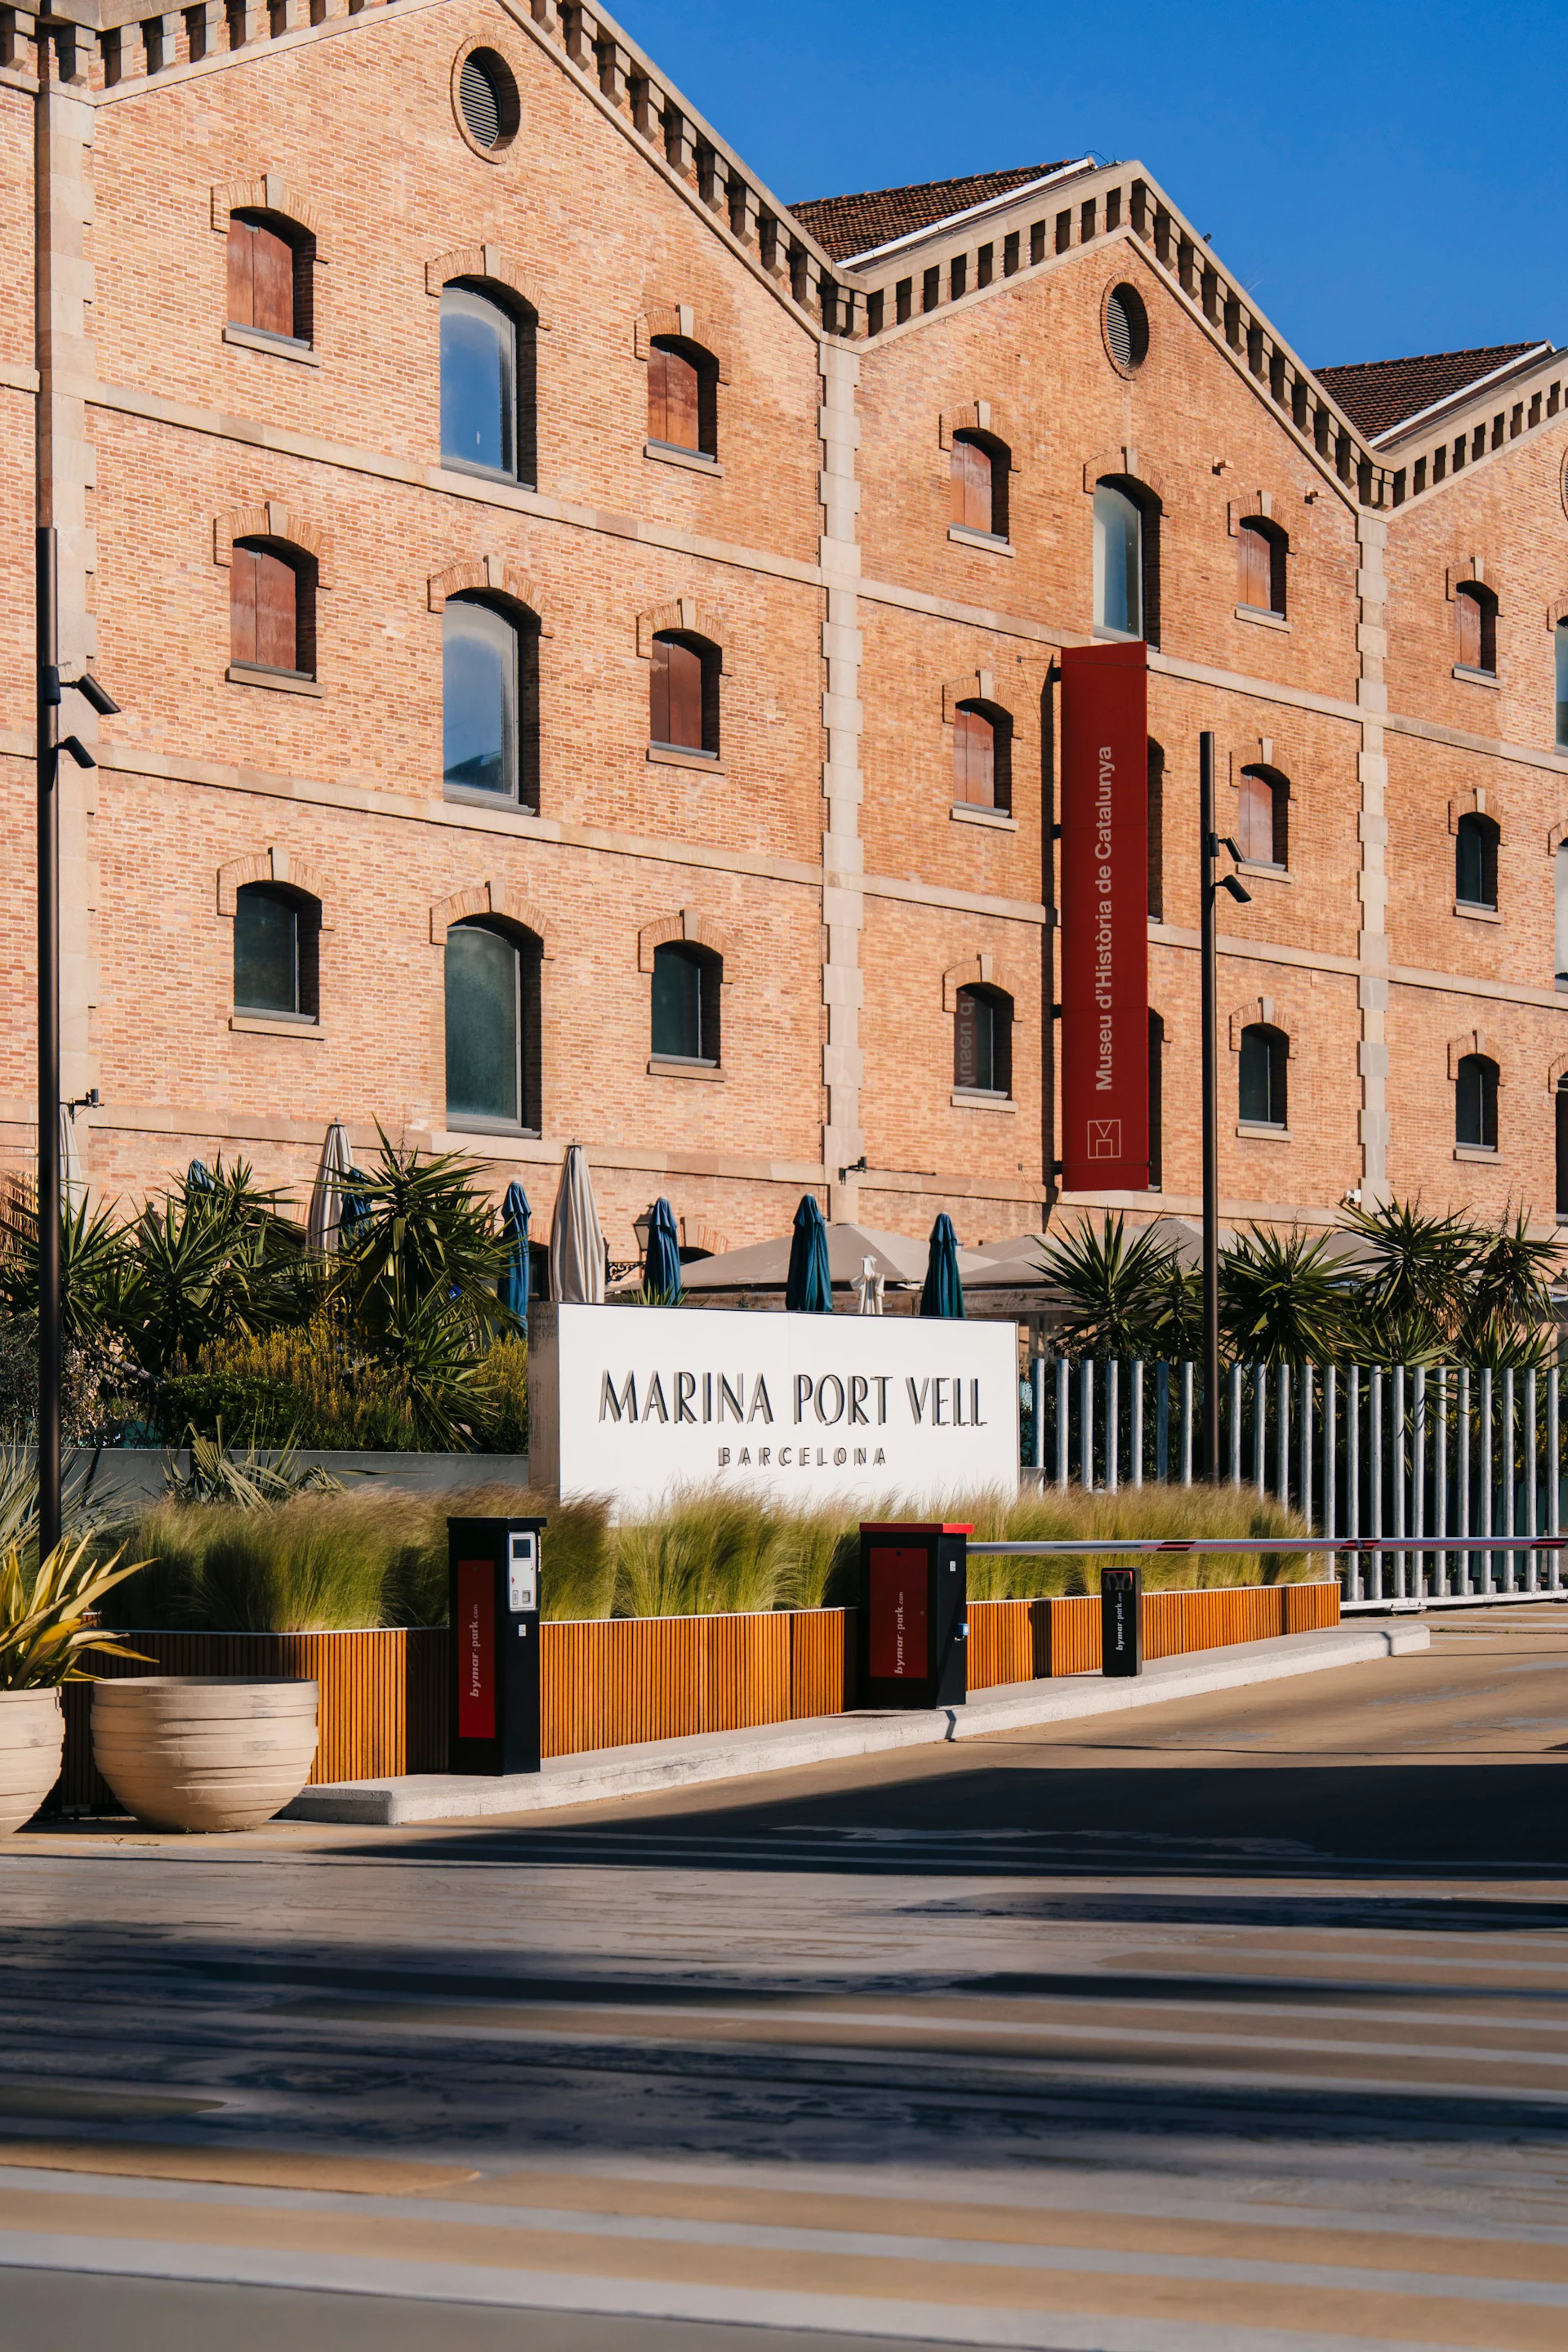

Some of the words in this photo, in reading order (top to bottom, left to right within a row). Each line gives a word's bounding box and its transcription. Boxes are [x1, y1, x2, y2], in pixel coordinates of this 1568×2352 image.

[1094, 746, 1116, 860] Catalunya
[1095, 865, 1111, 893] de
[1095, 1014, 1112, 1090] Museu
[599, 1369, 774, 1424] MARINA
[793, 1373, 893, 1427] PORT
[905, 1376, 987, 1427] VELL
[718, 1446, 887, 1467] BARCELONA
